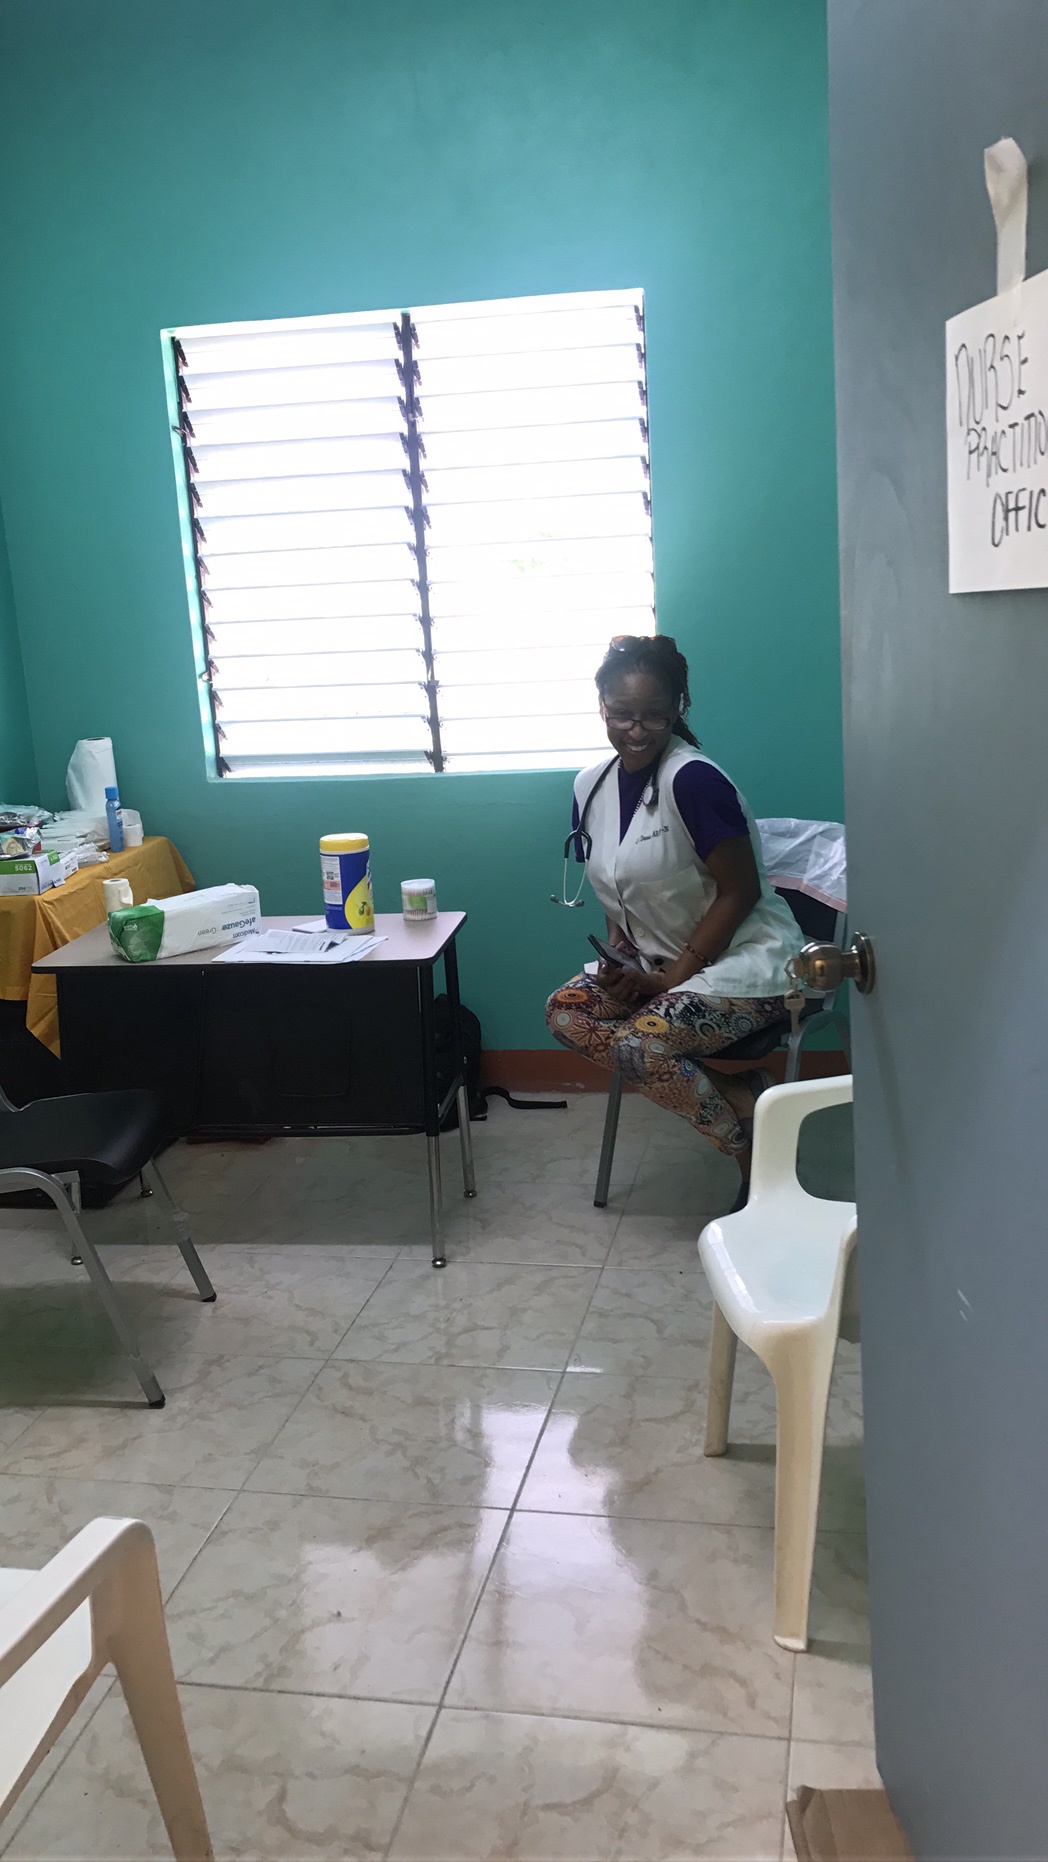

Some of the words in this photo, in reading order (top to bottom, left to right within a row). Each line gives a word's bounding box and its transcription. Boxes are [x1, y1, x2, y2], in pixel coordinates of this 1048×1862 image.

[955, 329, 1028, 427] NURSE
[198, 927, 217, 936] Green
[233, 928, 256, 938] Medicom
